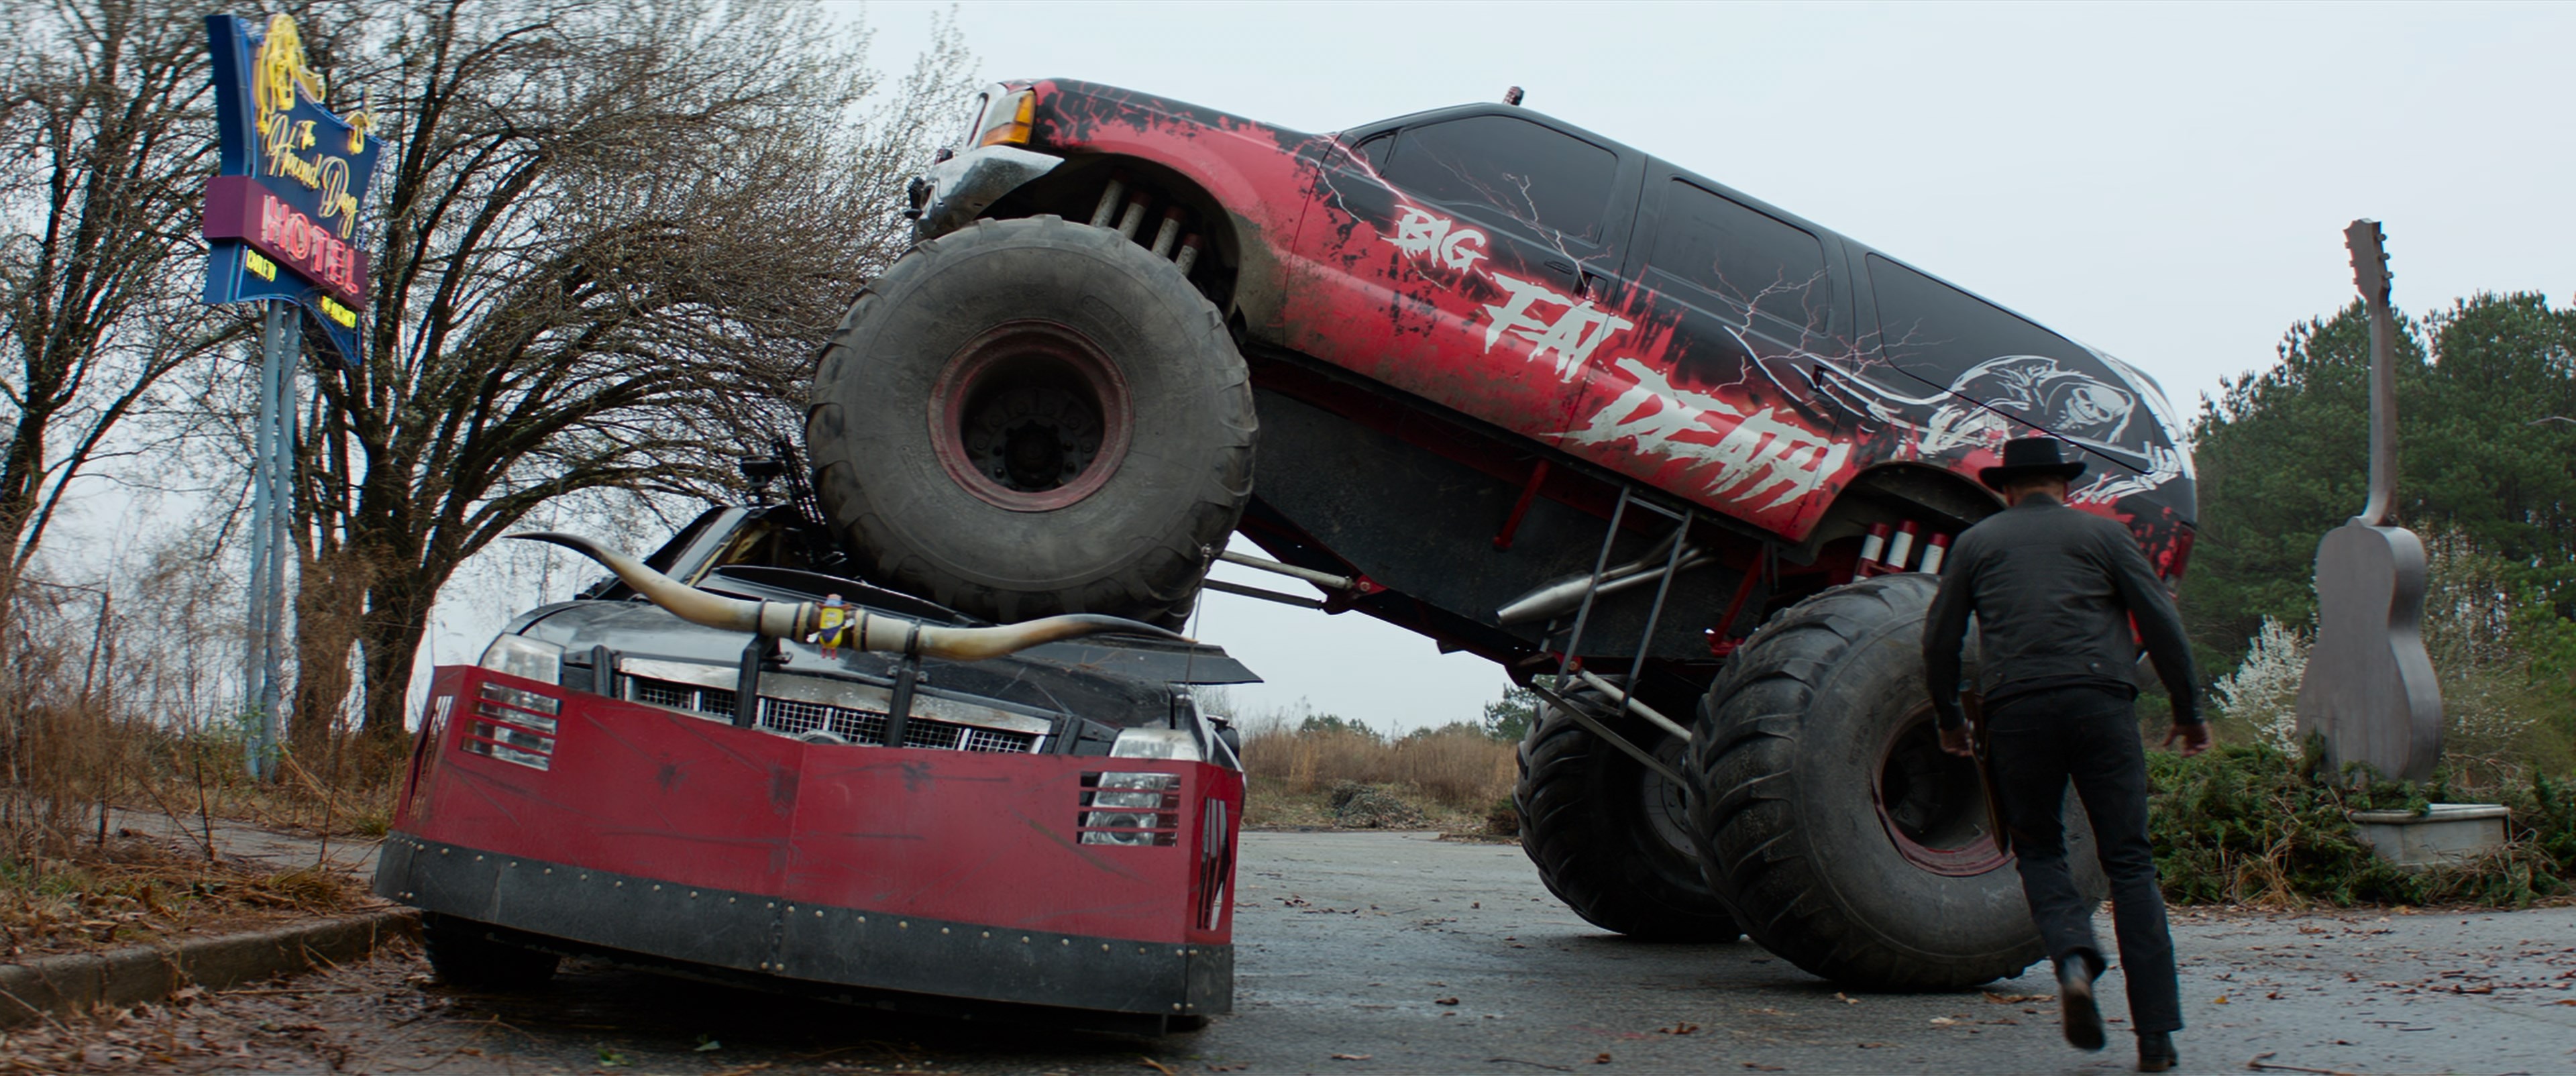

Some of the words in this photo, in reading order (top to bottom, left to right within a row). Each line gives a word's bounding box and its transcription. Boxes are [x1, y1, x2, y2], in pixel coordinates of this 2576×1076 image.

[264, 114, 321, 190] Hound
[319, 156, 359, 239] Dog
[297, 120, 317, 150] The
[262, 195, 359, 295] HOTEL
[1381, 205, 1489, 274] BIG
[1482, 272, 1634, 383] FAT
[1540, 357, 1851, 513] DEATH
